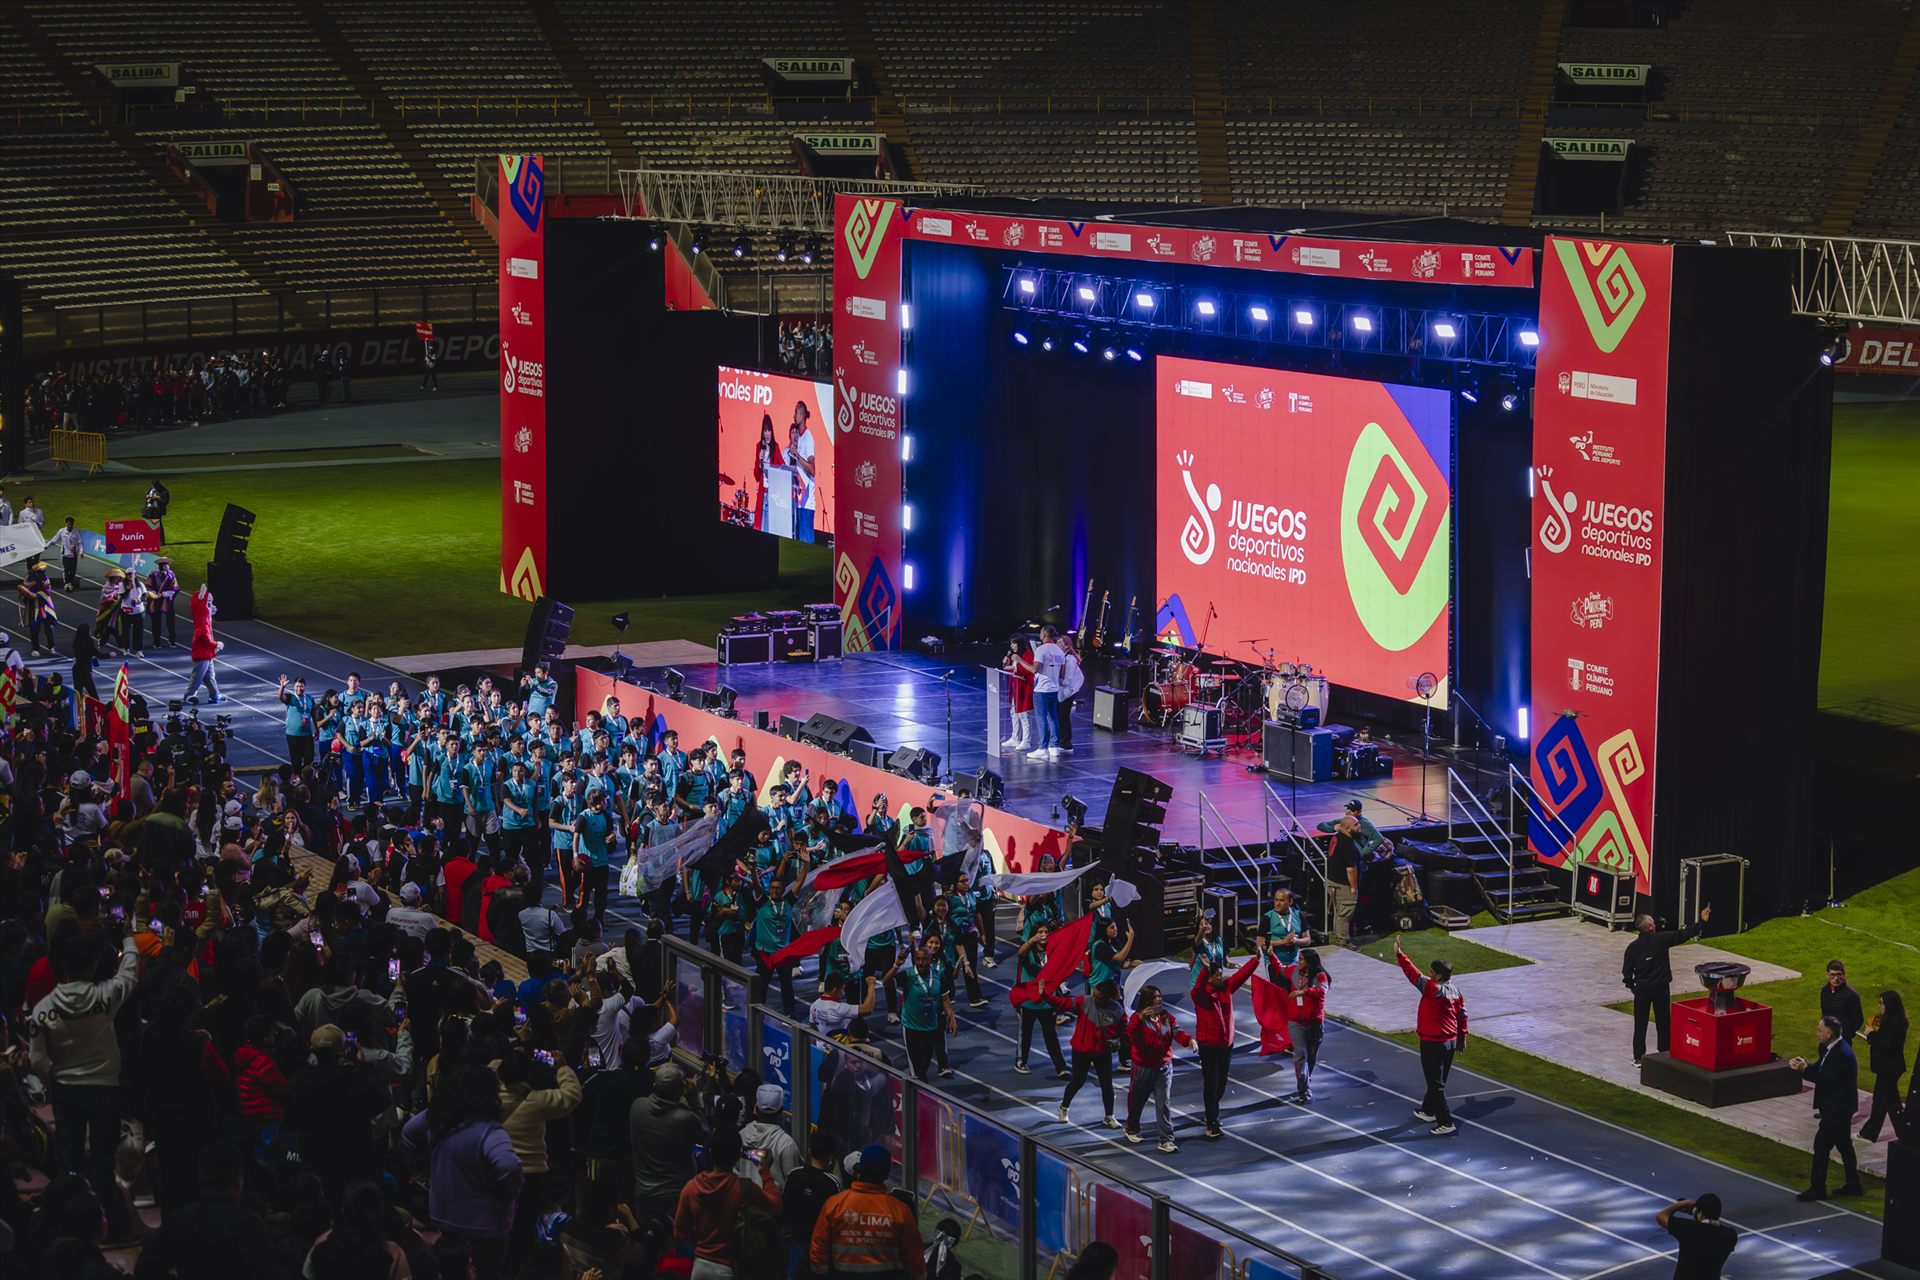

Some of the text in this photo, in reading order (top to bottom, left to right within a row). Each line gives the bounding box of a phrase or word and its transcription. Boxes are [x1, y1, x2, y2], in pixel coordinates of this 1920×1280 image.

[111, 67, 164, 78] SALIDA
[777, 62, 842, 72] SALIDA
[1571, 67, 1637, 78] SALIDA
[180, 144, 244, 158] SALIDA
[806, 138, 873, 149] SALIDA
[1555, 142, 1622, 153] SALIDA
[360, 339, 420, 367] DEL
[1859, 339, 1919, 367] DEL
[518, 360, 543, 377] JUEGOS
[752, 384, 773, 406] IPD
[860, 391, 896, 415] JUEGOS
[859, 408, 896, 429] deportivos
[1227, 499, 1308, 541] JUEGOS
[1582, 499, 1655, 533] JUEGOS
[120, 532, 145, 541] Junín
[1228, 528, 1305, 564] deportivos
[1581, 522, 1653, 551] deportivos
[1581, 544, 1652, 567] nacionales IPD
[1227, 557, 1307, 585] nacionales IPD
[1586, 683, 1613, 697] PERUANO
[769, 1054, 782, 1068] IPD
[860, 1216, 892, 1227] LIMA
